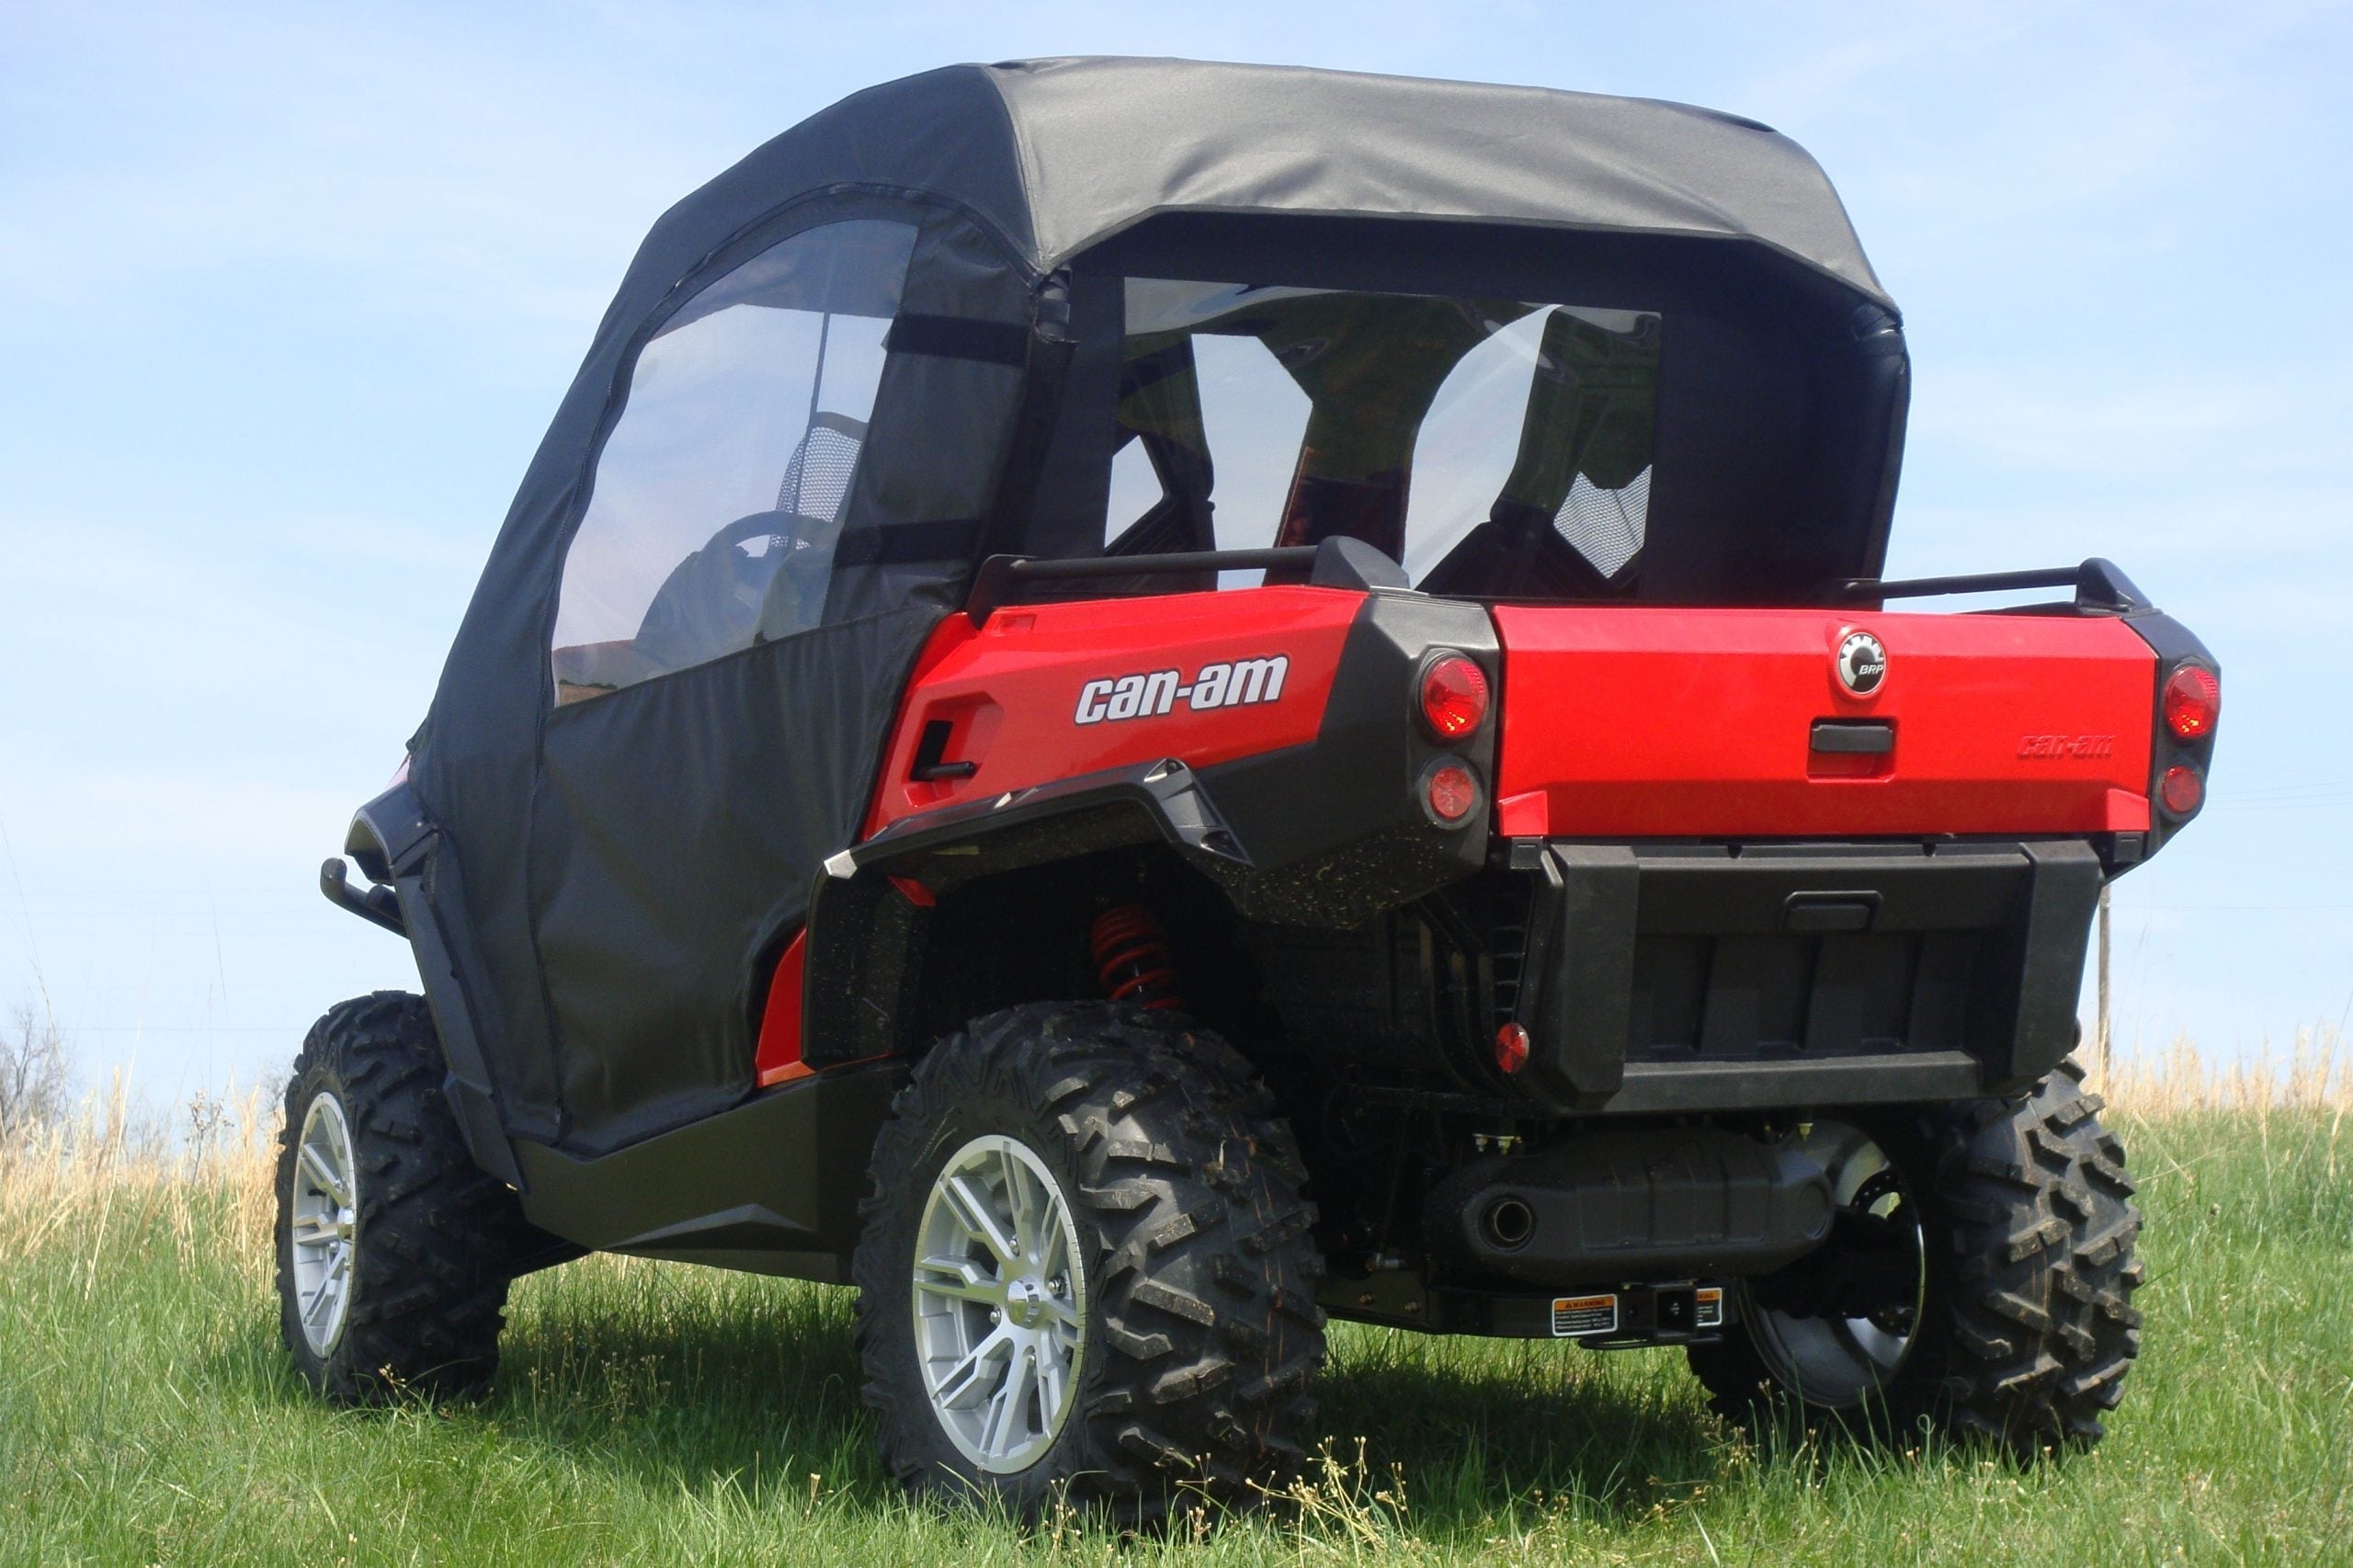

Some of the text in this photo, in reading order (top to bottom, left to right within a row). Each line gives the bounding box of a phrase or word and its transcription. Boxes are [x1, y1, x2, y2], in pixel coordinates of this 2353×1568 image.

[1859, 664, 1884, 676] BRP
[1074, 655, 1290, 725] can-am
[1573, 1299, 1605, 1308] WARNING
